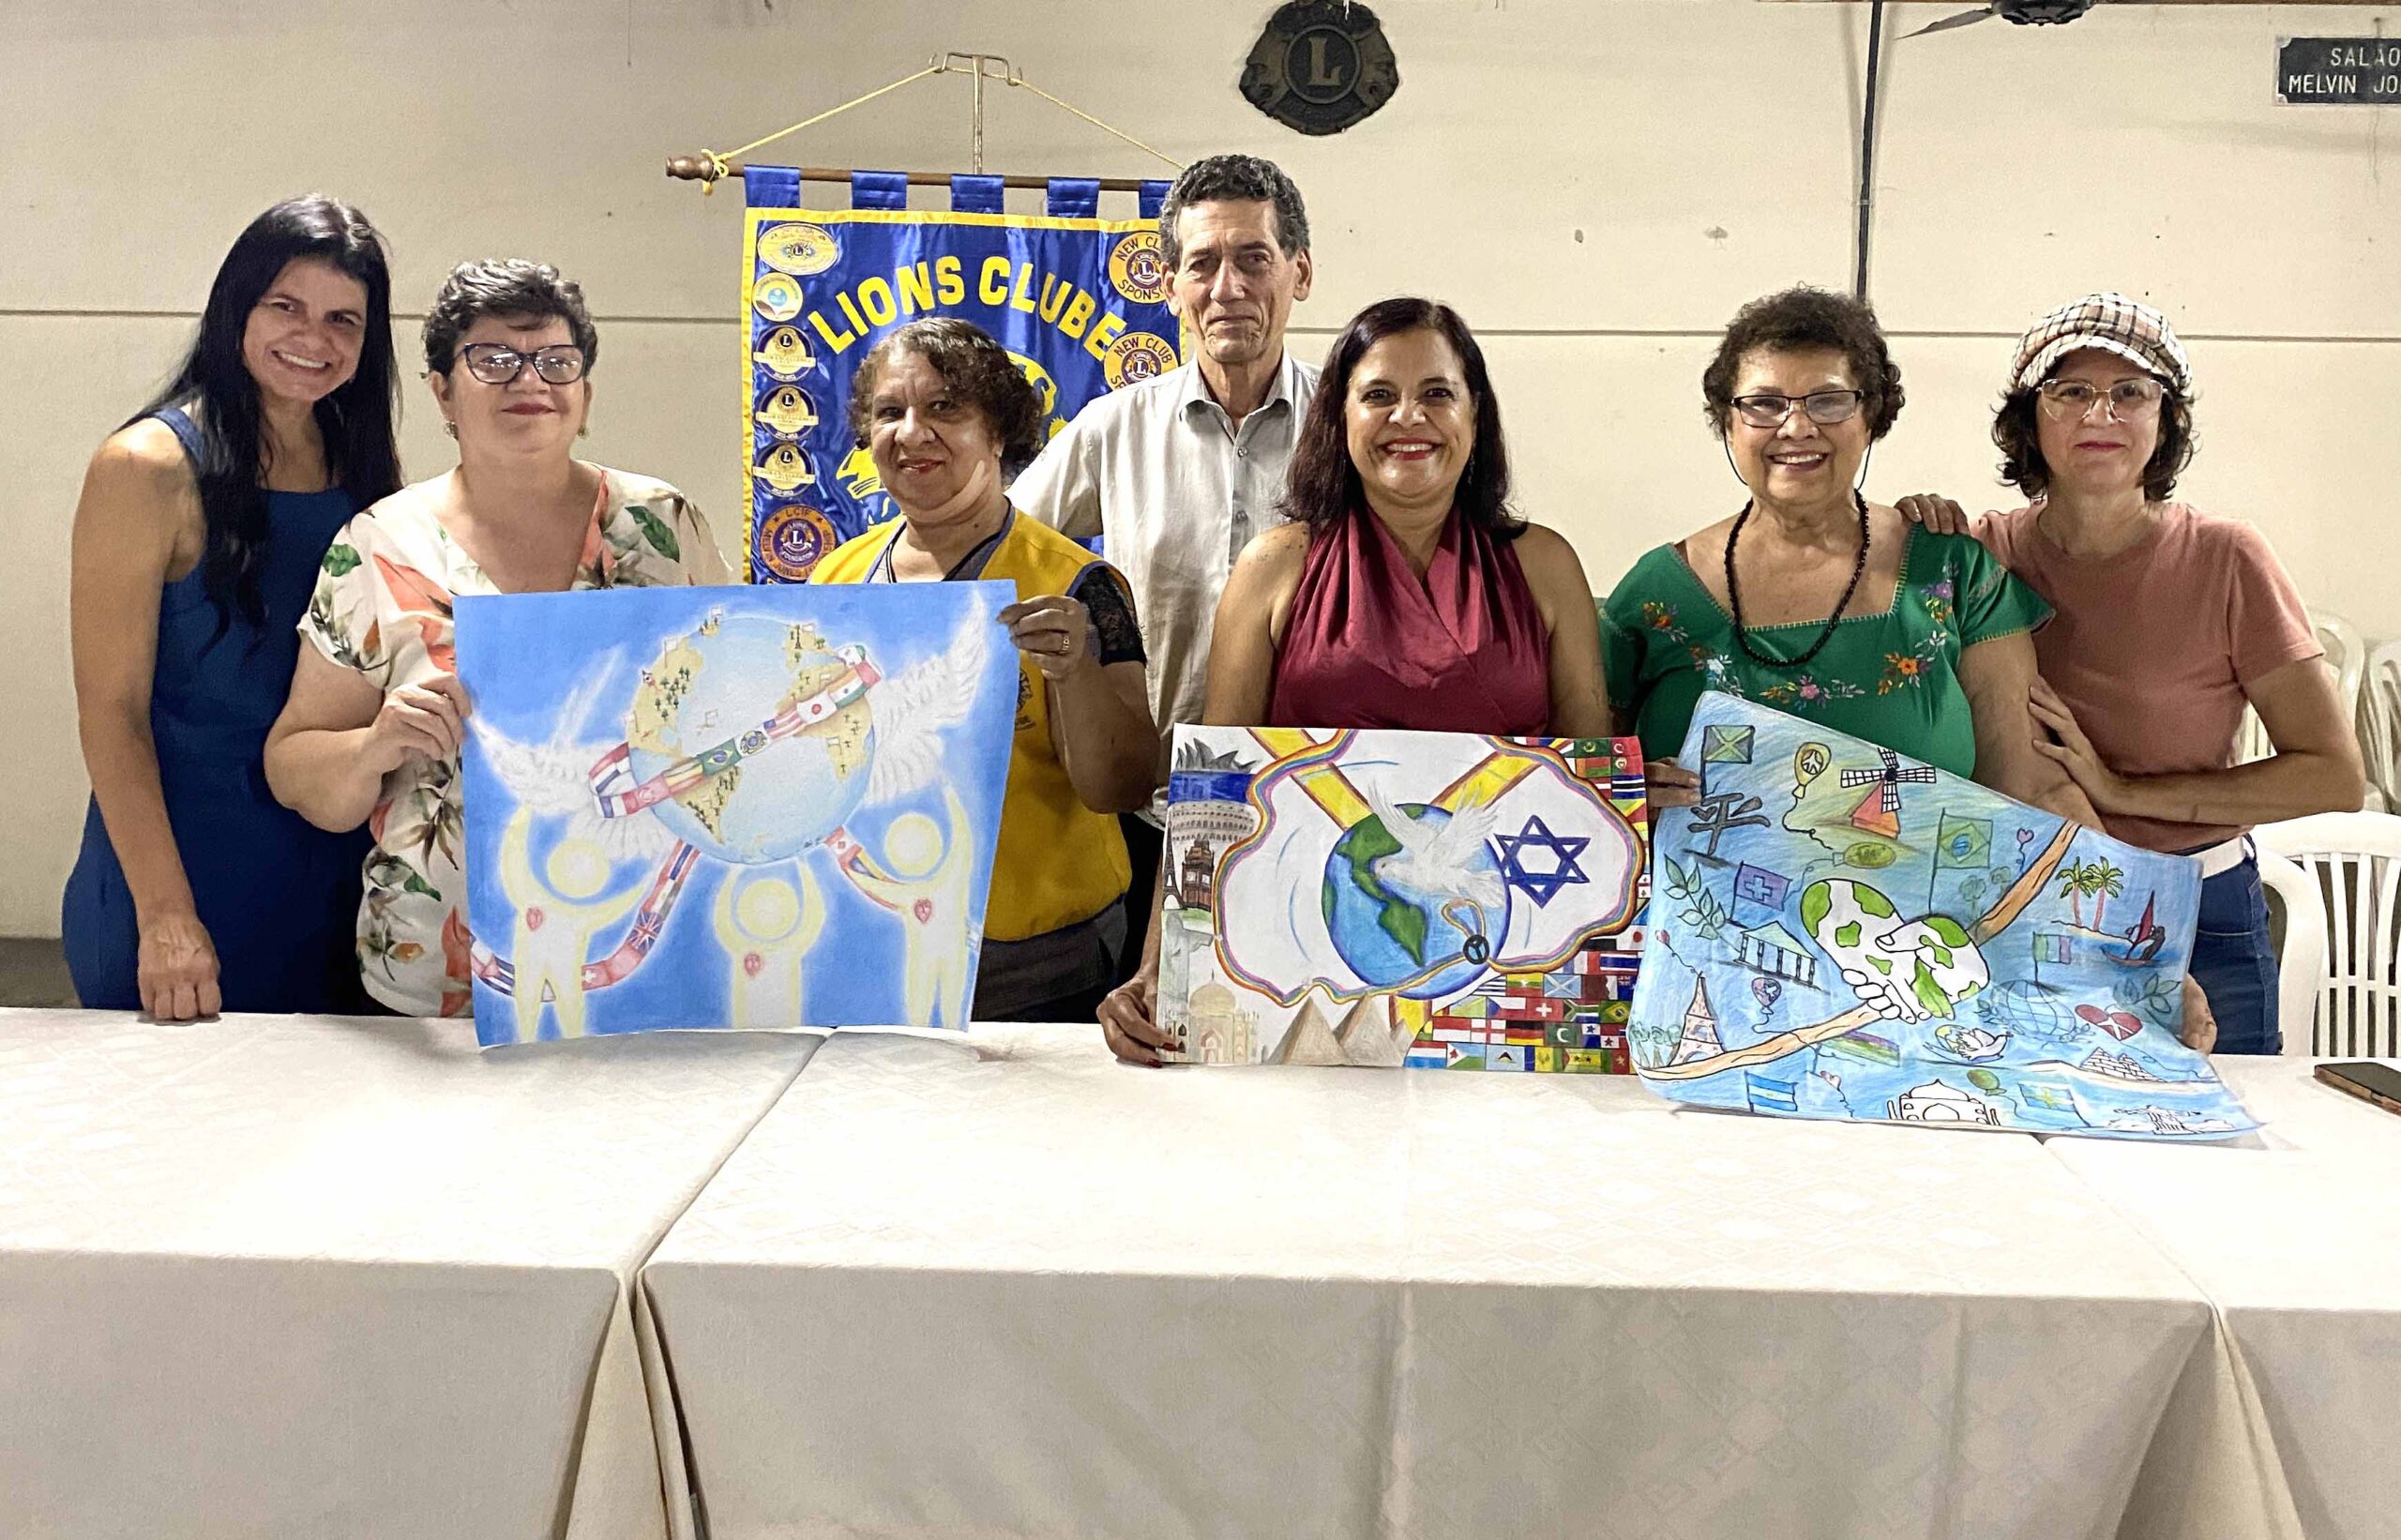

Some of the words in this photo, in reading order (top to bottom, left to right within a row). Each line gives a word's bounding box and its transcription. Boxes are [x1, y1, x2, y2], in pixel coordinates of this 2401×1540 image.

[1307, 36, 1342, 86] L
[2288, 74, 2357, 94] MELVIN
[2373, 74, 2401, 94] JO
[1115, 237, 1140, 262] NEW
[1145, 235, 1162, 251] CL
[808, 255, 966, 355] LIONS
[979, 256, 1127, 362] CLUBE
[782, 335, 791, 346] L
[1113, 336, 1140, 357] NEW
[1145, 338, 1173, 364] CLUB
[784, 394, 793, 405] L
[782, 451, 792, 462] L
[785, 507, 811, 518] LCIF
[792, 530, 803, 544] L
